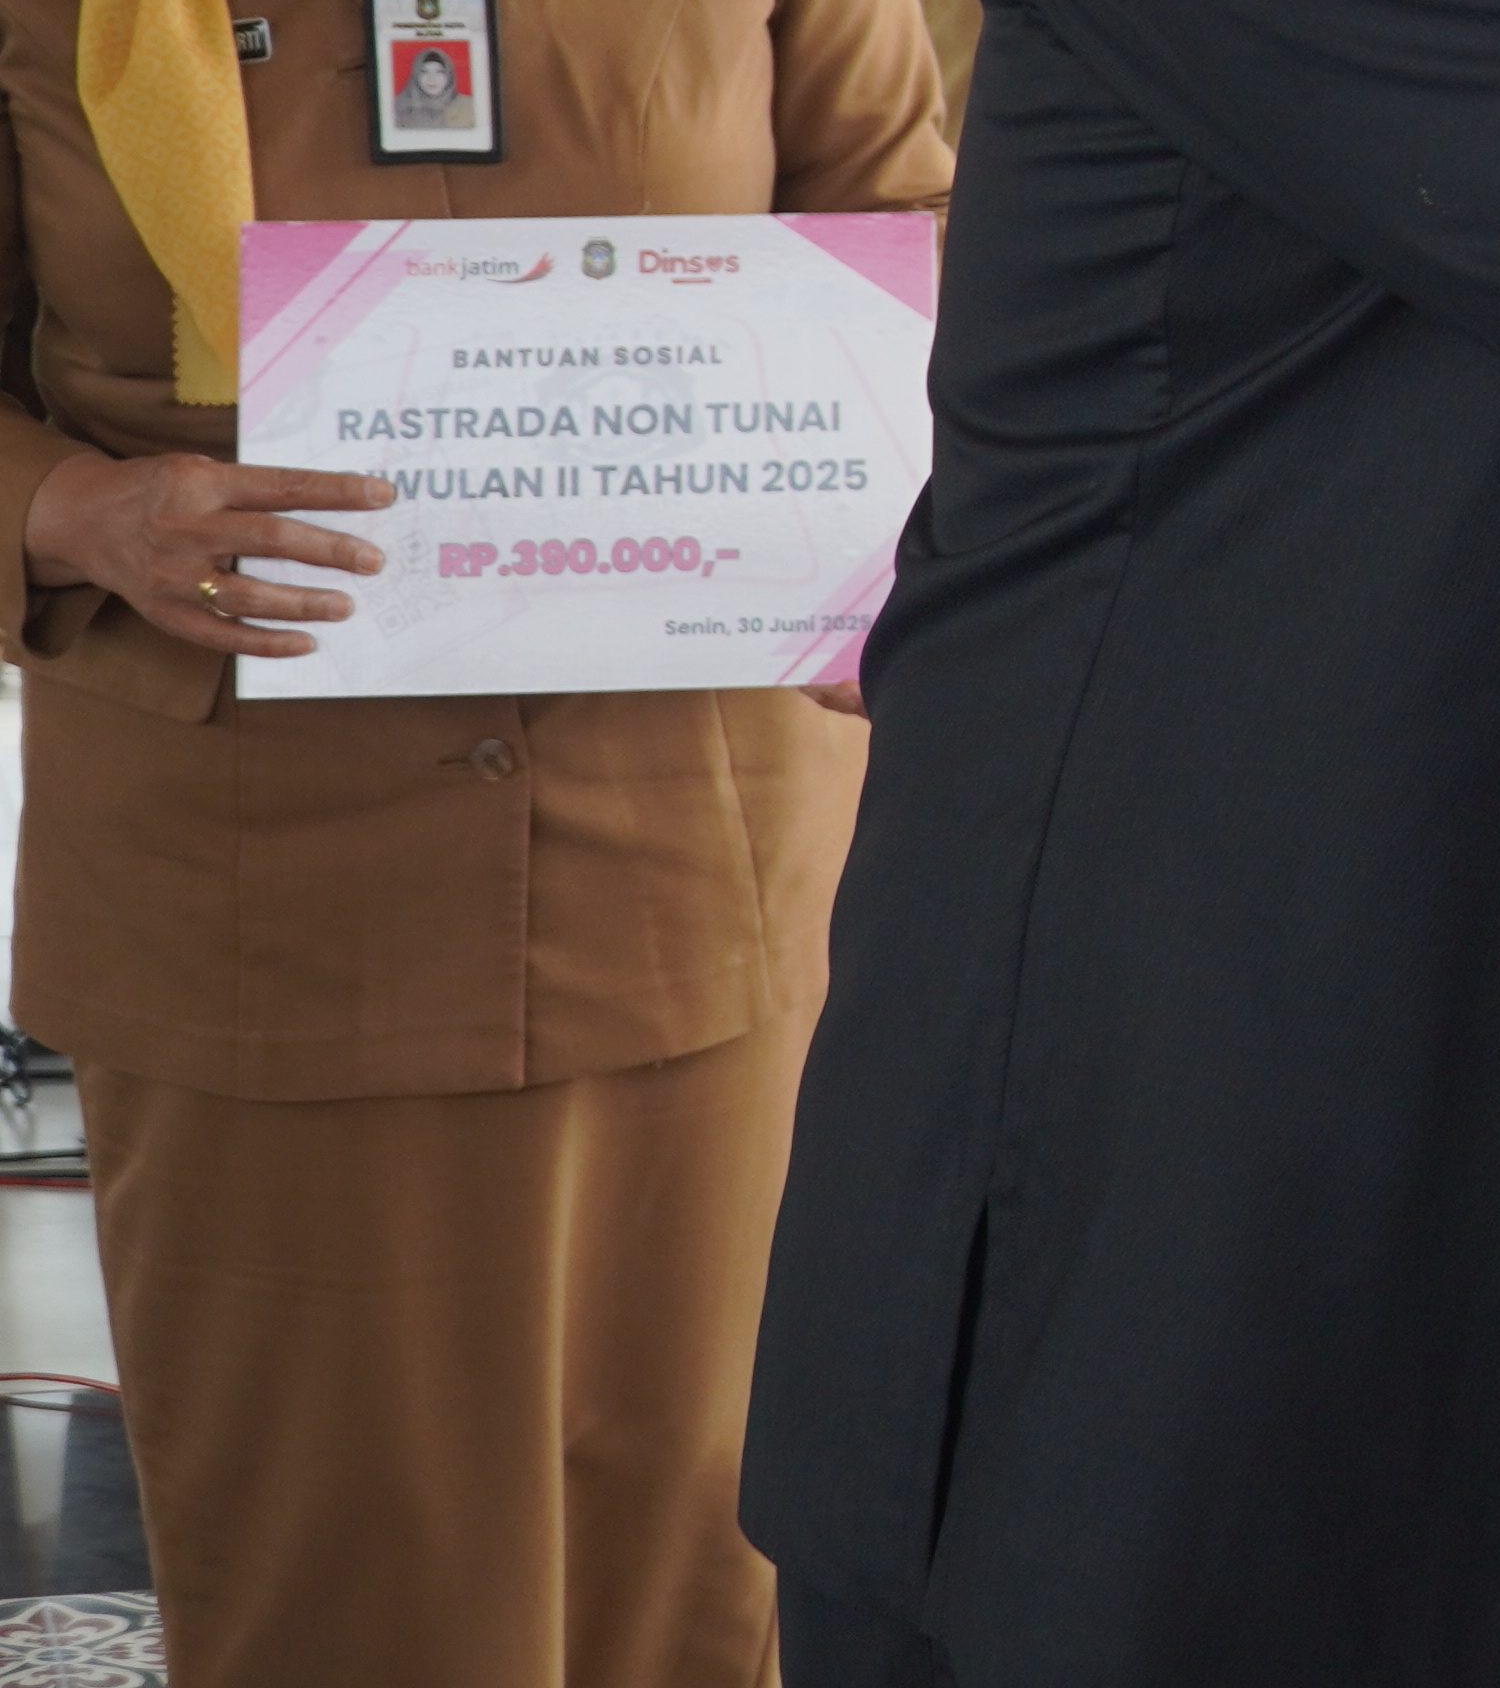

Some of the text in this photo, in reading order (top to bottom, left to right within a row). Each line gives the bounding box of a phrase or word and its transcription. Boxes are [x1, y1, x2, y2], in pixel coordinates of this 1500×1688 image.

[405, 256, 519, 281] bankjatim
[452, 344, 723, 370] BANTUAN SOSIAL
[339, 403, 839, 440] RASTRADA NON TUNAI
[366, 466, 543, 501] WULAN
[593, 464, 747, 495] TAHUN
[762, 460, 867, 492] 2025
[440, 538, 738, 577] RP.390.000,-
[665, 613, 872, 639] Senin, 30 Juni 2025
